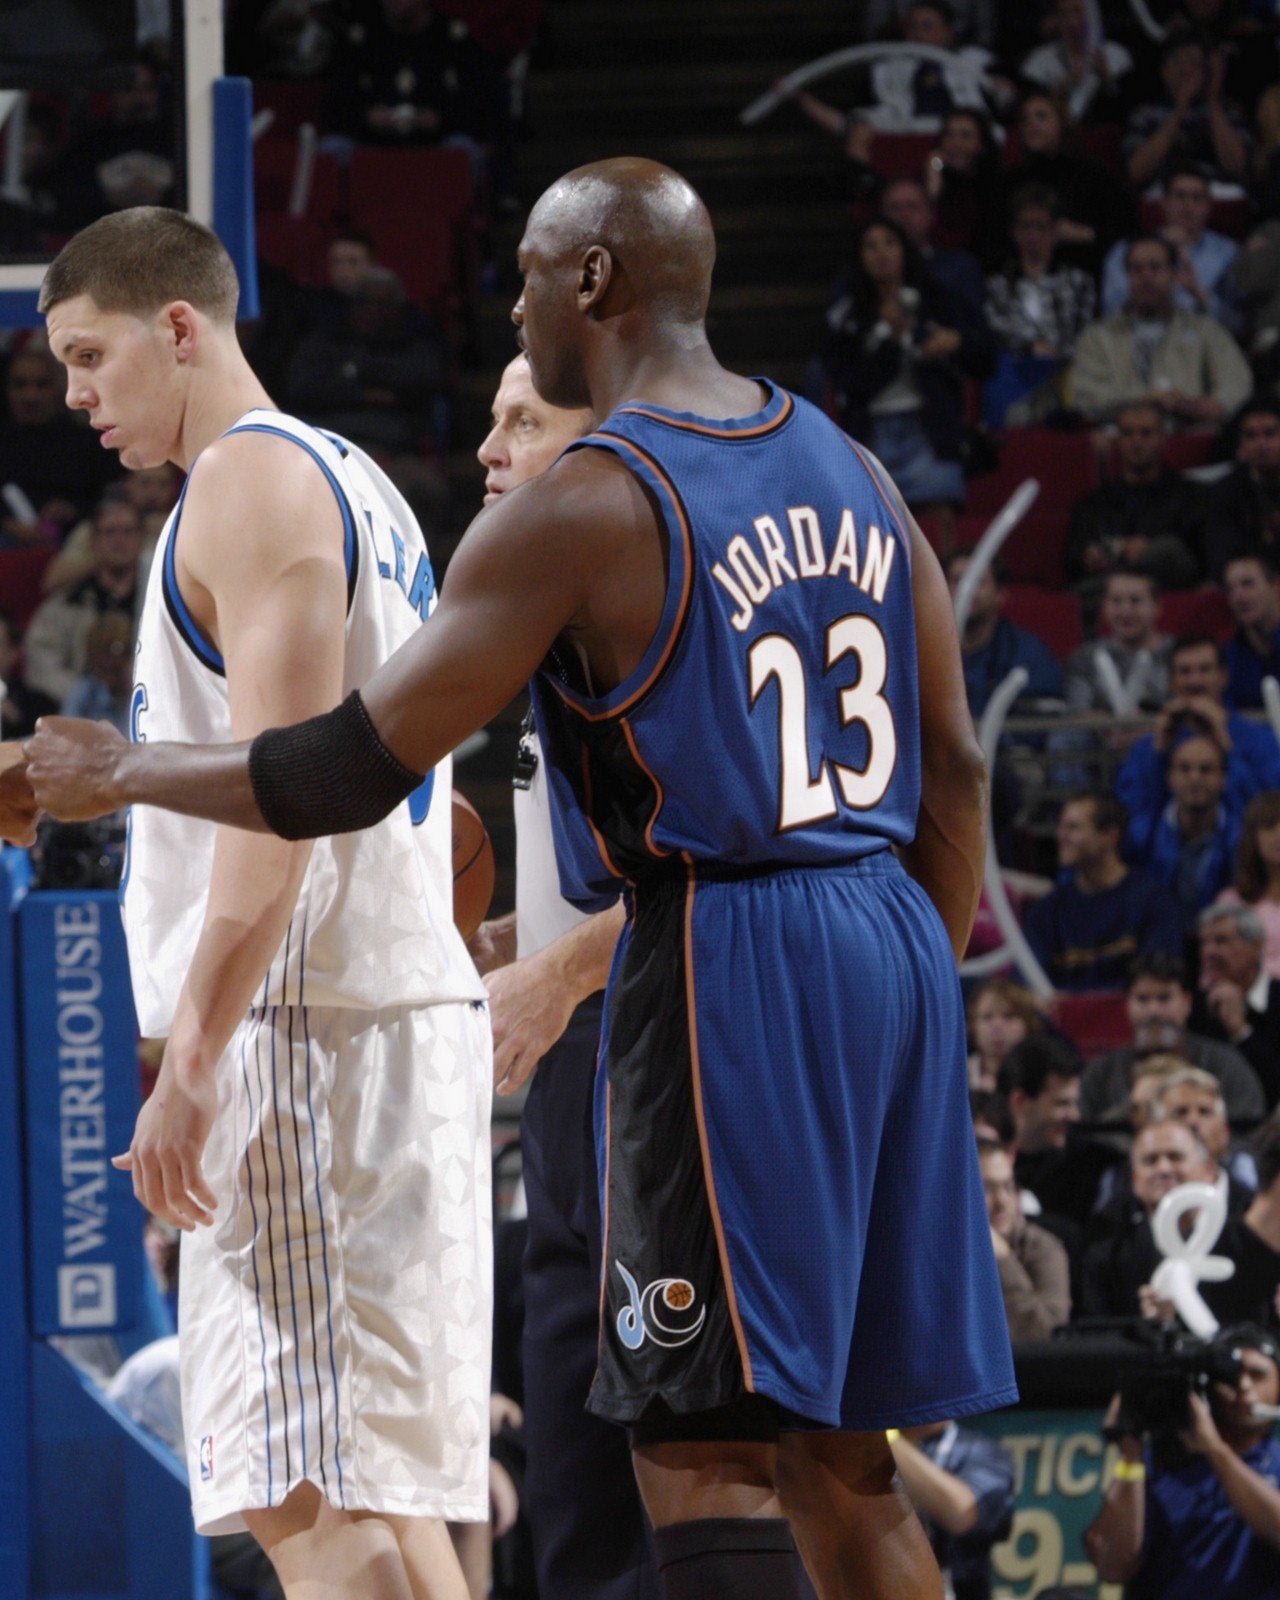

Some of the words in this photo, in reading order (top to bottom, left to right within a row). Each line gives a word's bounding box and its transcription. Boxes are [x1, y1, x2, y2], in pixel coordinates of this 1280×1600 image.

[712, 505, 896, 632] JORDAN
[748, 612, 898, 835] 23
[54, 902, 107, 1259] WATERHOUSE
